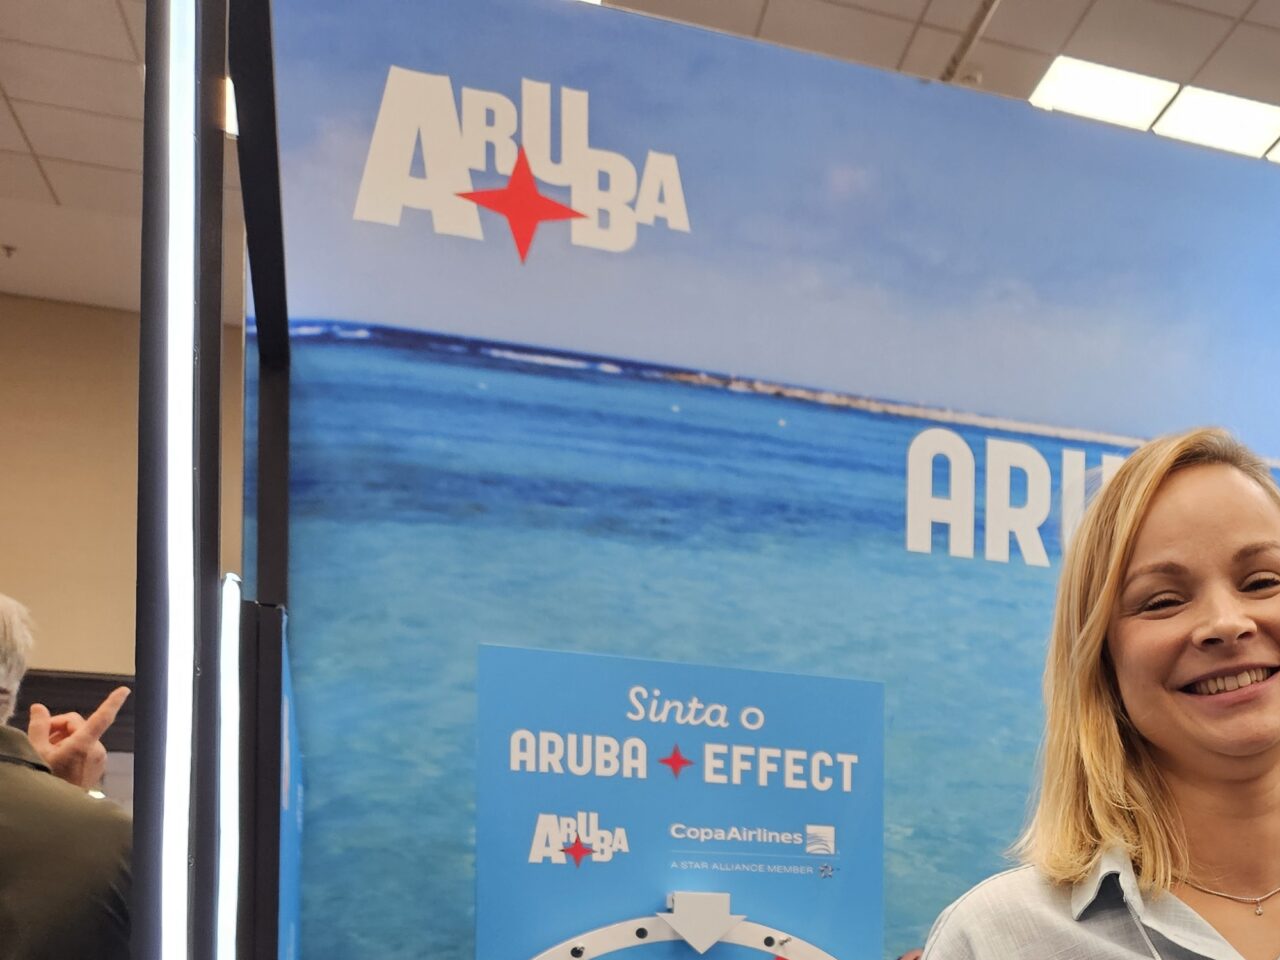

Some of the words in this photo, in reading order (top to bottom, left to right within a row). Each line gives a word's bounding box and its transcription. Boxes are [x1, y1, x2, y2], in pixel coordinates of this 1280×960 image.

[353, 65, 691, 253] ARUBA
[626, 685, 729, 729] Sinta
[740, 706, 765, 731] o
[510, 729, 647, 779] ARUBA
[703, 743, 858, 792] EFFECT
[528, 811, 629, 864] ARUBA
[680, 861, 709, 870] STAR
[712, 862, 765, 873] ALLIANCE
[767, 865, 813, 875] MEMBER
